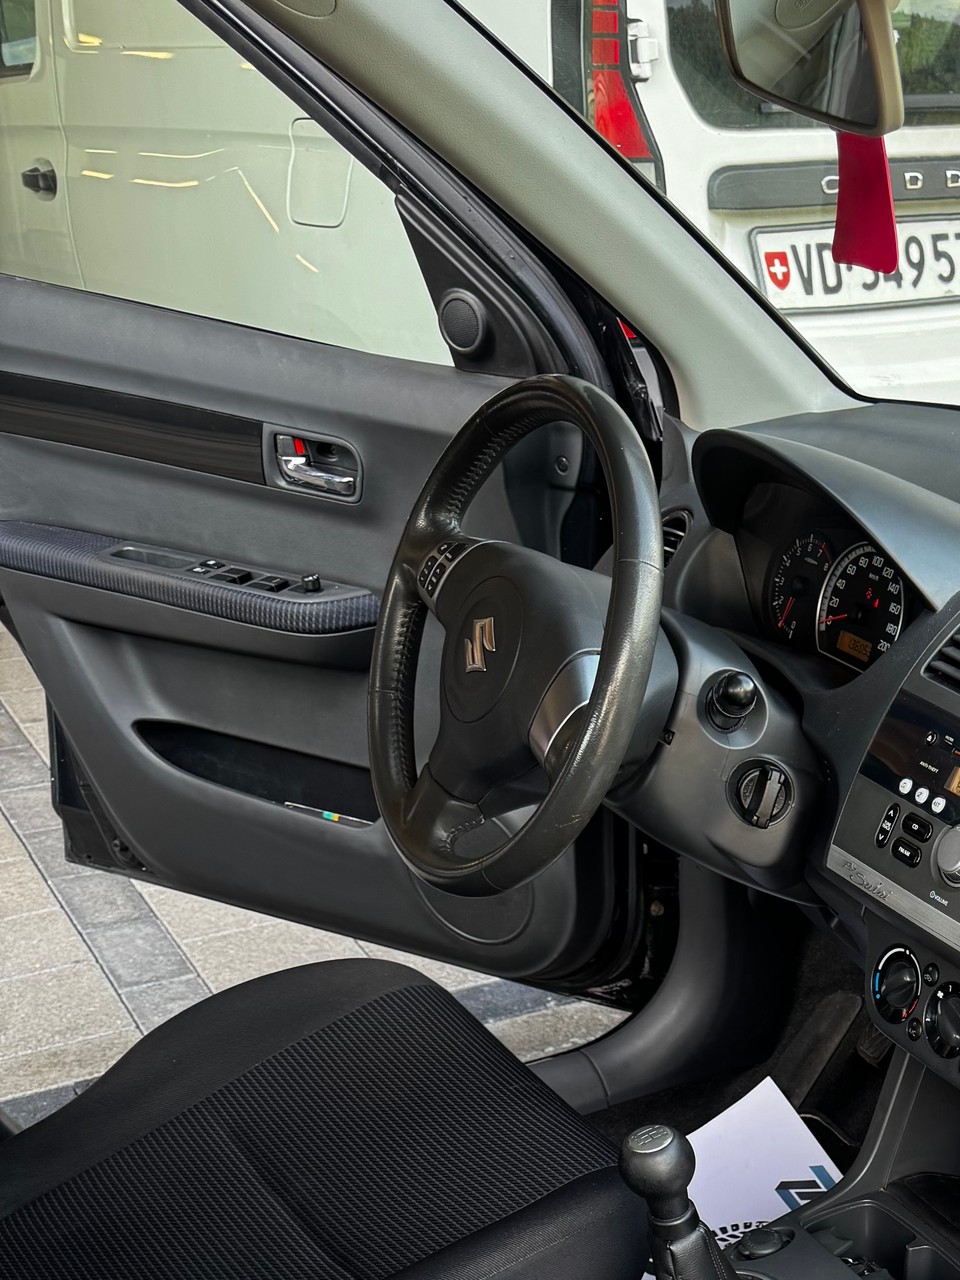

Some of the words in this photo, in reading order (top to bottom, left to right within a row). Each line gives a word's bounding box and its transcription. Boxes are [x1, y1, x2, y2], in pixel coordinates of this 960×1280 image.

[859, 558, 868, 568] 80
[871, 556, 884, 567] 100
[846, 564, 856, 575] 60
[882, 567, 894, 579] 120
[836, 579, 846, 589] 40
[887, 582, 900, 594] 140
[829, 596, 839, 607] 20
[889, 602, 901, 615] 160
[886, 623, 898, 635] 180
